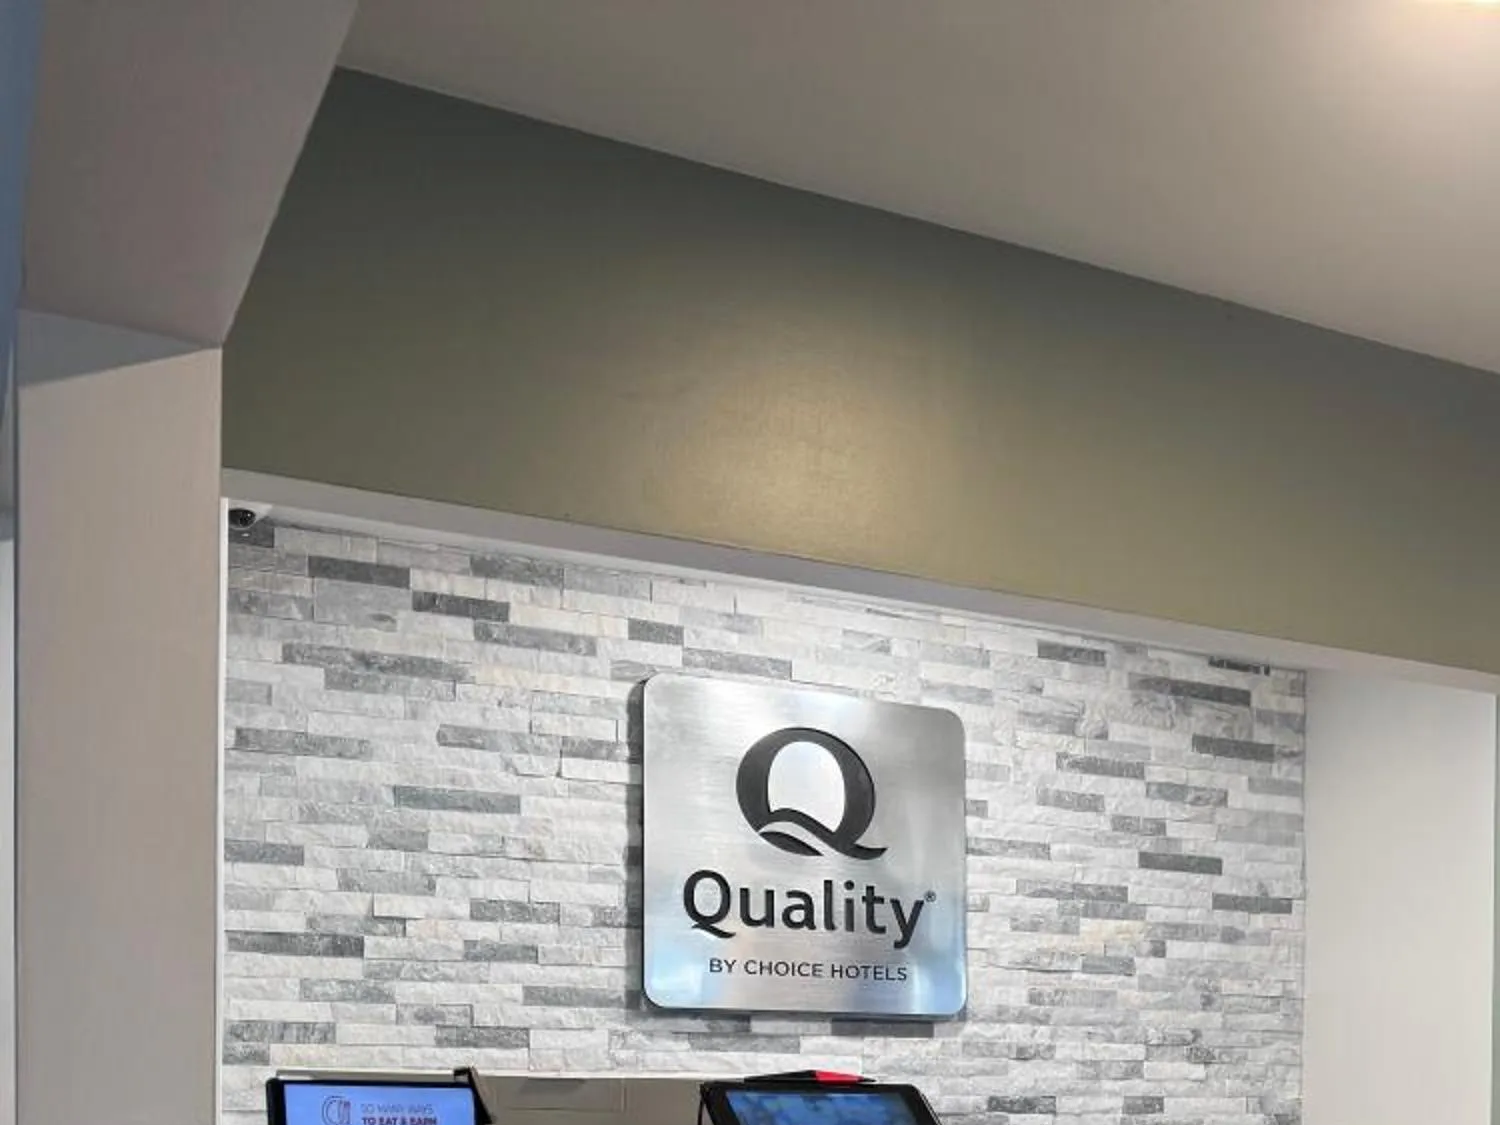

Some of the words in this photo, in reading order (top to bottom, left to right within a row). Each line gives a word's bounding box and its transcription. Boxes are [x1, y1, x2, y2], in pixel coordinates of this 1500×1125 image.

[709, 958, 738, 974] BY
[744, 959, 823, 978] CHOICE
[830, 963, 908, 982] HOTELS
